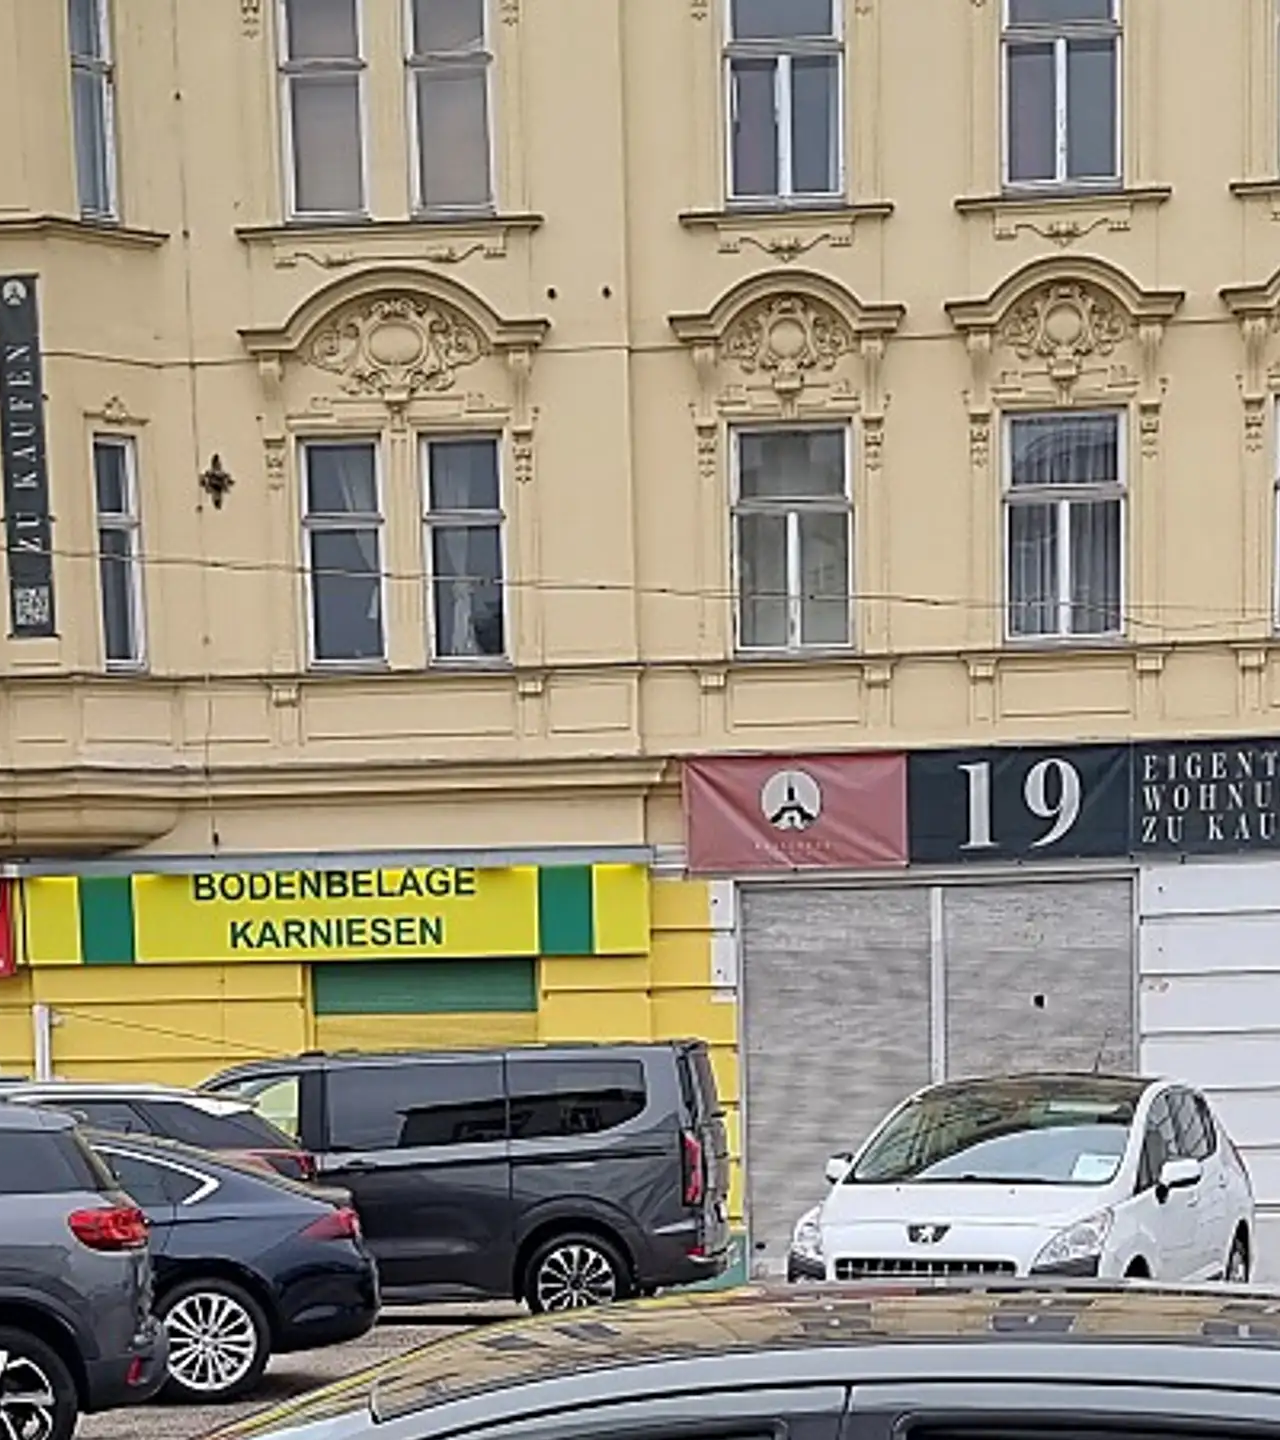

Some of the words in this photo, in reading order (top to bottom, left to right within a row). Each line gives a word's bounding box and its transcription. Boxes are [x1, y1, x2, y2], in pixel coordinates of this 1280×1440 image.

[6, 345, 39, 488] KAUFEN
[956, 758, 1080, 850] 19
[1141, 814, 1184, 843] ZU
[229, 915, 444, 949] KARNIESEN
